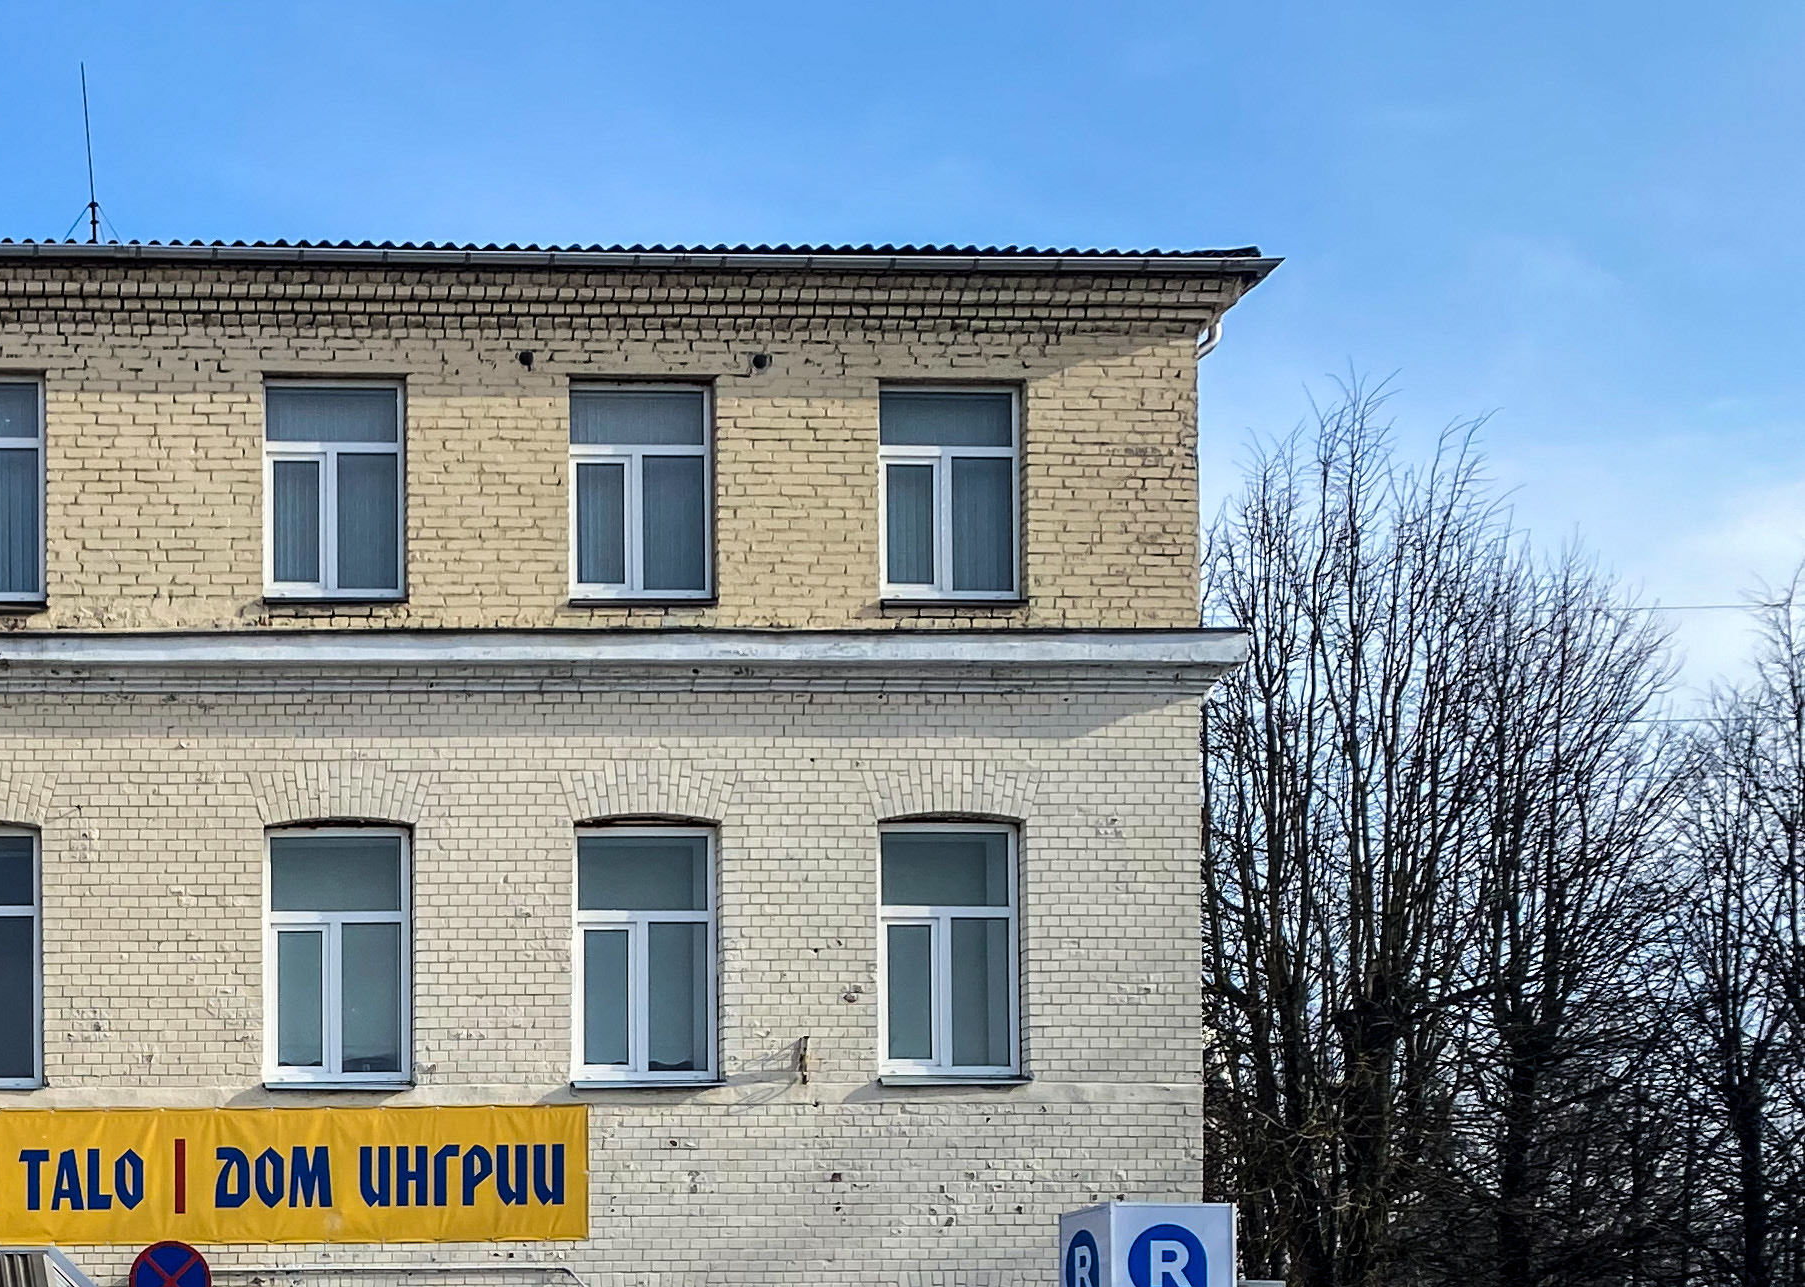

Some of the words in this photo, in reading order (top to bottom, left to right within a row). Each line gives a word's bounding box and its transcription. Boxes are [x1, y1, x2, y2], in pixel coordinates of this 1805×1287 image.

[19, 1148, 144, 1211] TALO
[215, 1146, 332, 1208] ДОМ
[359, 1144, 565, 1207] ИНГРИИ
[1149, 1240, 1192, 1287] R
